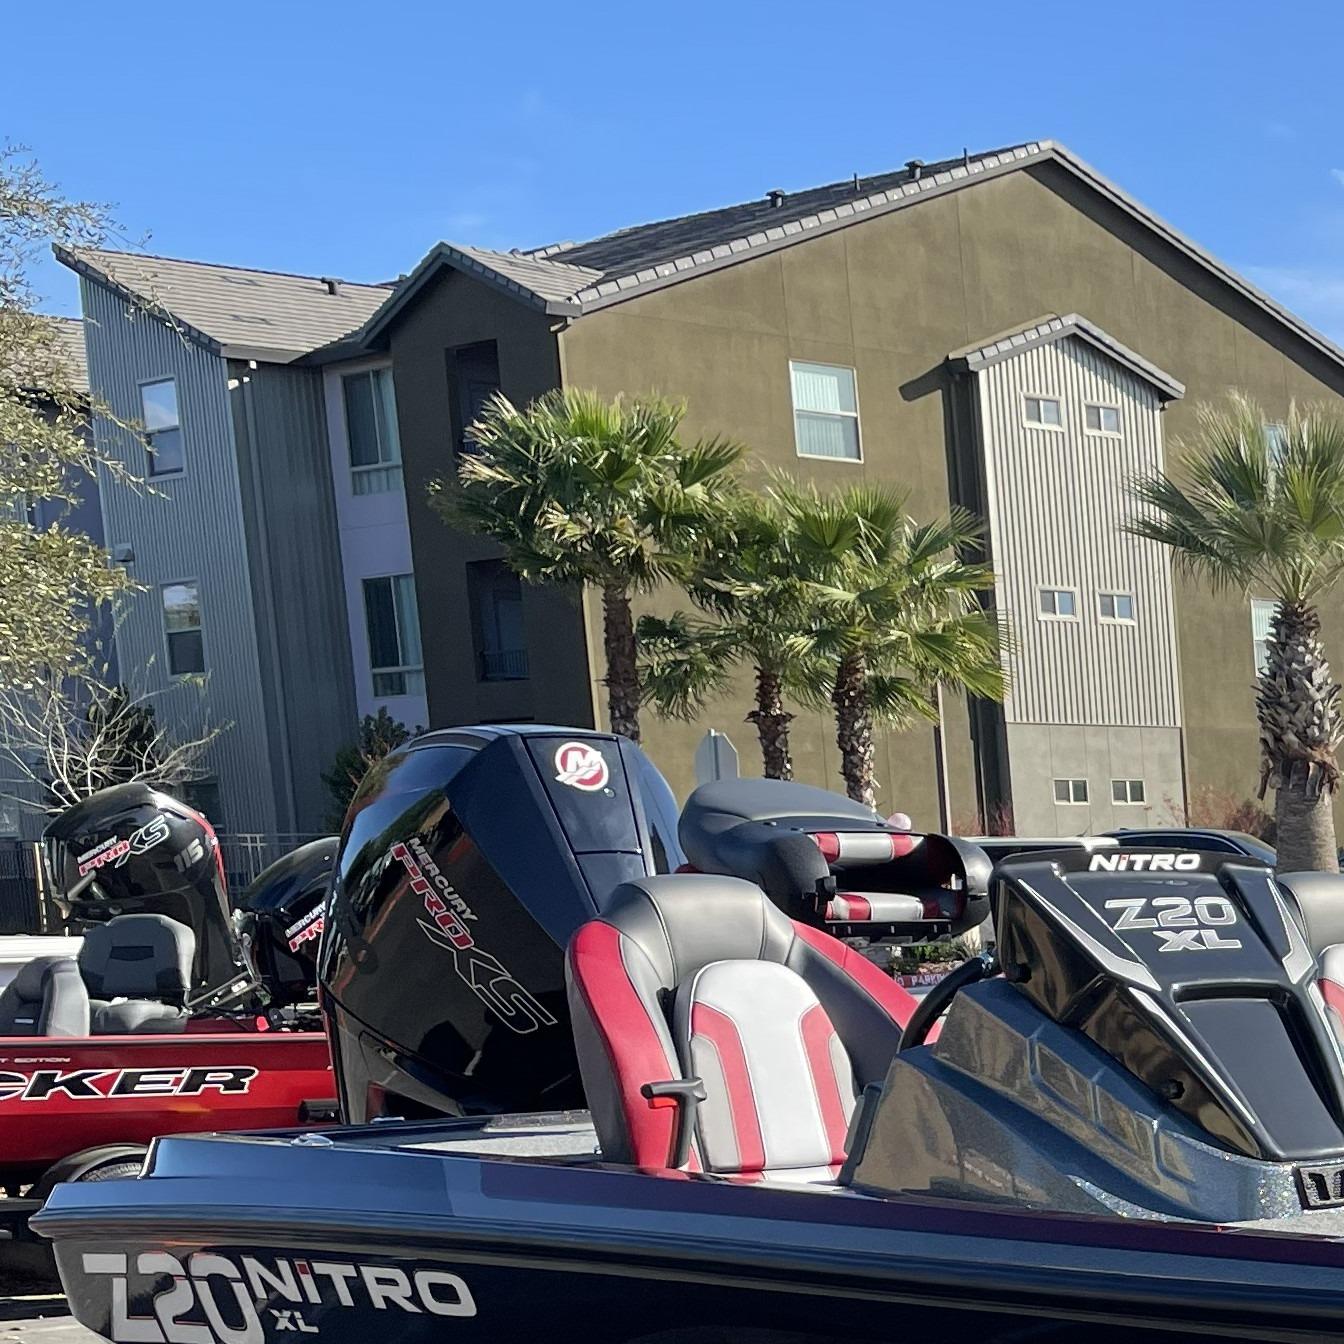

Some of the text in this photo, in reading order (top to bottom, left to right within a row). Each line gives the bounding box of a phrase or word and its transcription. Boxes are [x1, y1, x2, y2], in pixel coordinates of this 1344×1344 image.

[77, 835, 118, 864] MERCURY
[79, 814, 170, 876] PRO XS
[174, 838, 204, 872] 115
[408, 837, 478, 921] MERCURY
[1104, 896, 1237, 930] Z20
[289, 918, 325, 952] PR
[391, 842, 558, 1034] PRO XS
[1153, 929, 1242, 951] XL
[270, 1308, 319, 1333] XL
